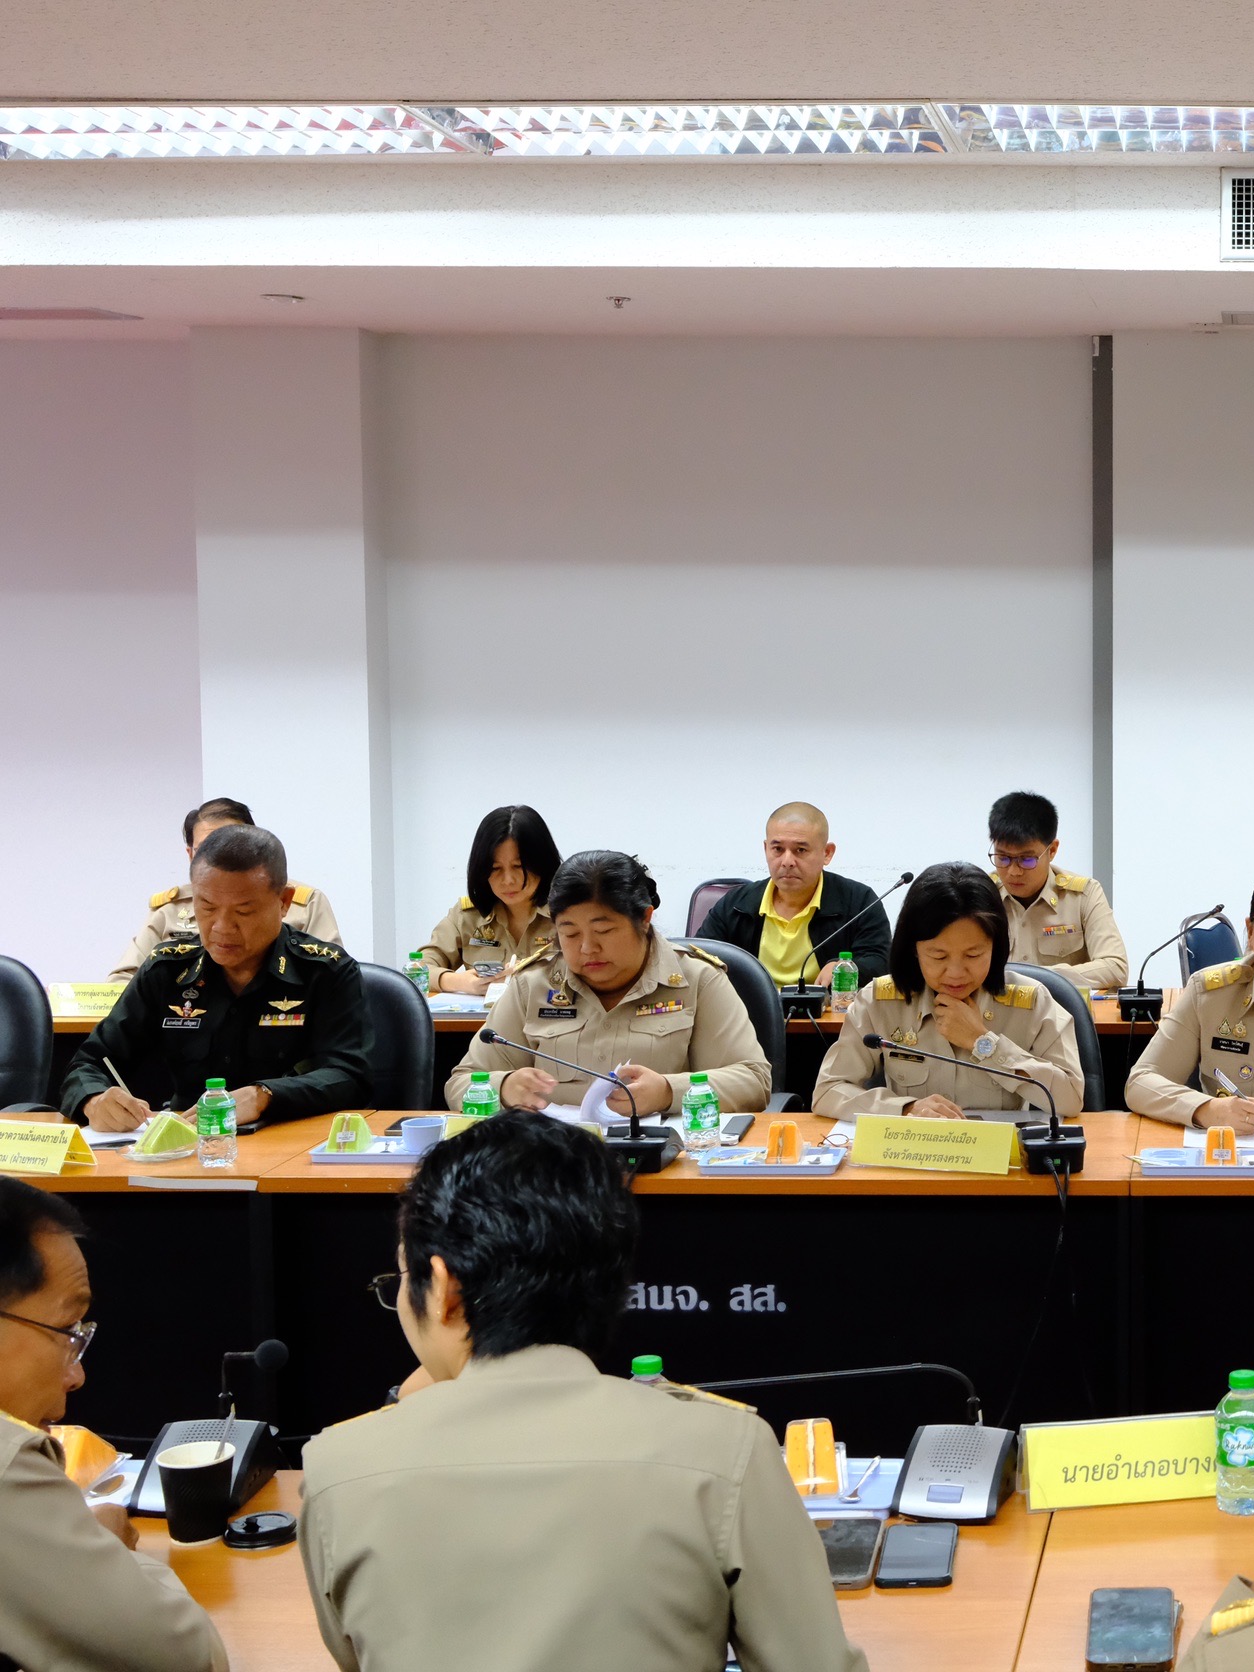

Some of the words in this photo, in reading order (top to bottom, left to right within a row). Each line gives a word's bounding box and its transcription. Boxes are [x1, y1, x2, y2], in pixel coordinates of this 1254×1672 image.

[883, 1127, 977, 1145] โยธาธิการและผังเมือง
[882, 1147, 972, 1165] จังหวัดสมุทรสงคราม
[729, 1284, 787, 1312] สส.
